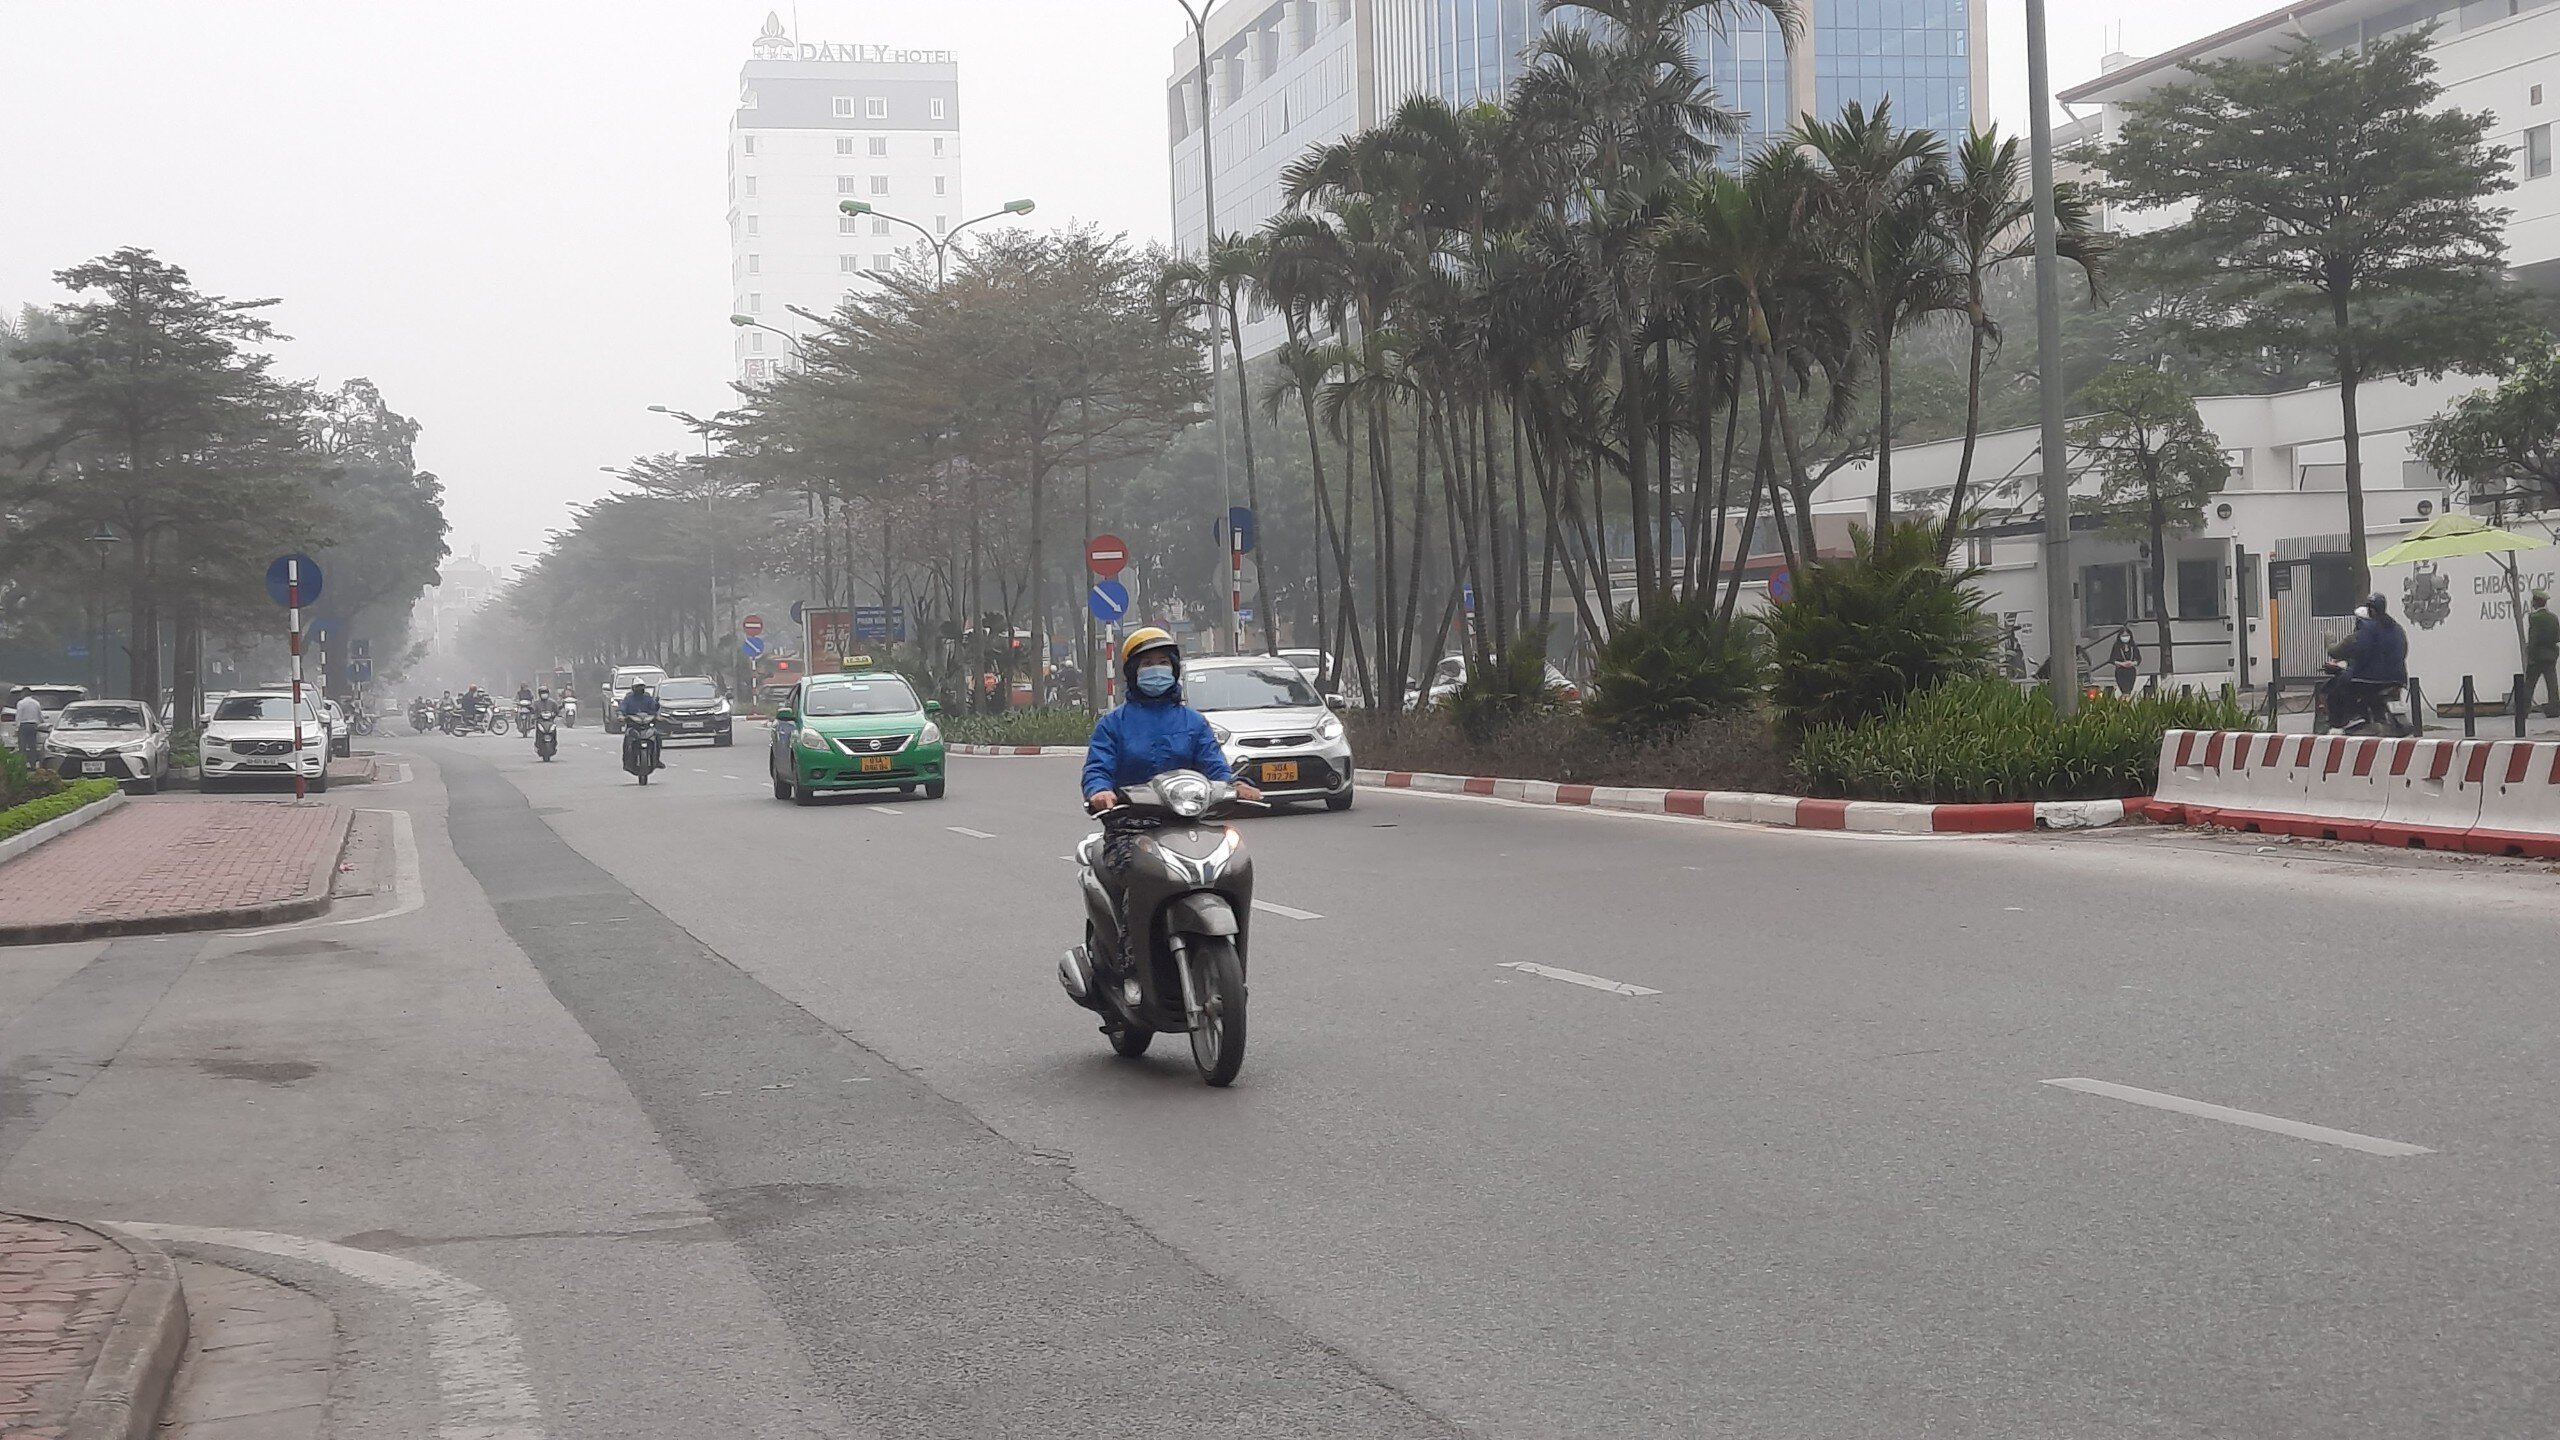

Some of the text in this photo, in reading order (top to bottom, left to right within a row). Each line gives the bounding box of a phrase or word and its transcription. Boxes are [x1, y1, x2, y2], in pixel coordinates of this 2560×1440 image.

[799, 42, 957, 64] DANLY HOTEL
[2537, 571, 2555, 590] OF
